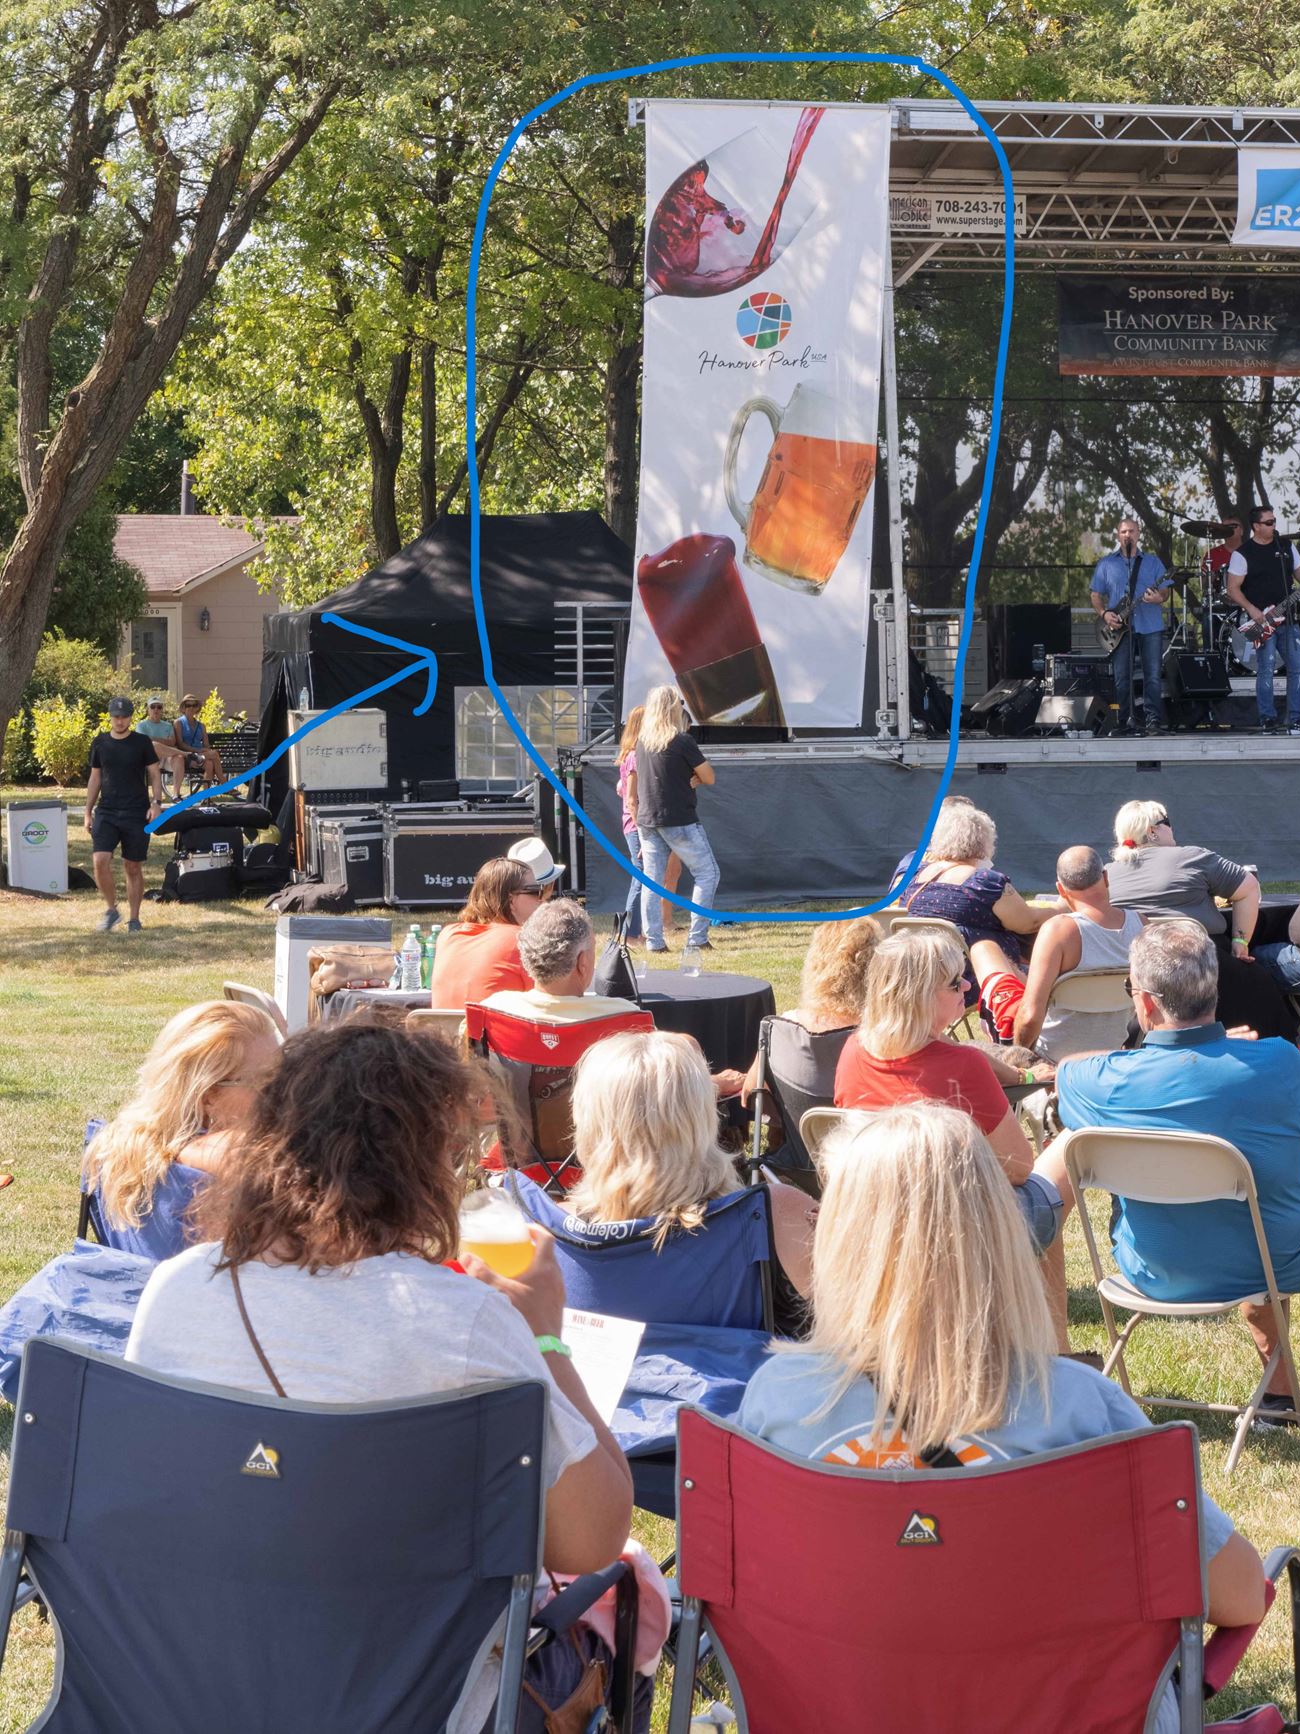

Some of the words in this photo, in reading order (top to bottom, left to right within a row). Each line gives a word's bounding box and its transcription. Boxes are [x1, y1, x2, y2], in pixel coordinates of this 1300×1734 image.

[936, 216, 1023, 228] www.superstage.m
[1128, 286, 1207, 302] Sponsored
[1211, 287, 1235, 304] By:
[1103, 309, 1214, 331] HANOVER
[1220, 310, 1278, 331] PARK
[1113, 335, 1218, 351] COMMUNITY
[1223, 336, 1268, 352] BANK
[698, 350, 766, 375] Hanover
[768, 345, 810, 371] Park
[1177, 358, 1240, 368] COMMUNITY
[1243, 358, 1270, 369] BANK
[424, 873, 455, 888] big
[575, 1222, 628, 1240] Coleman
[246, 1461, 271, 1471] GCI
[904, 1531, 930, 1539] GCI
